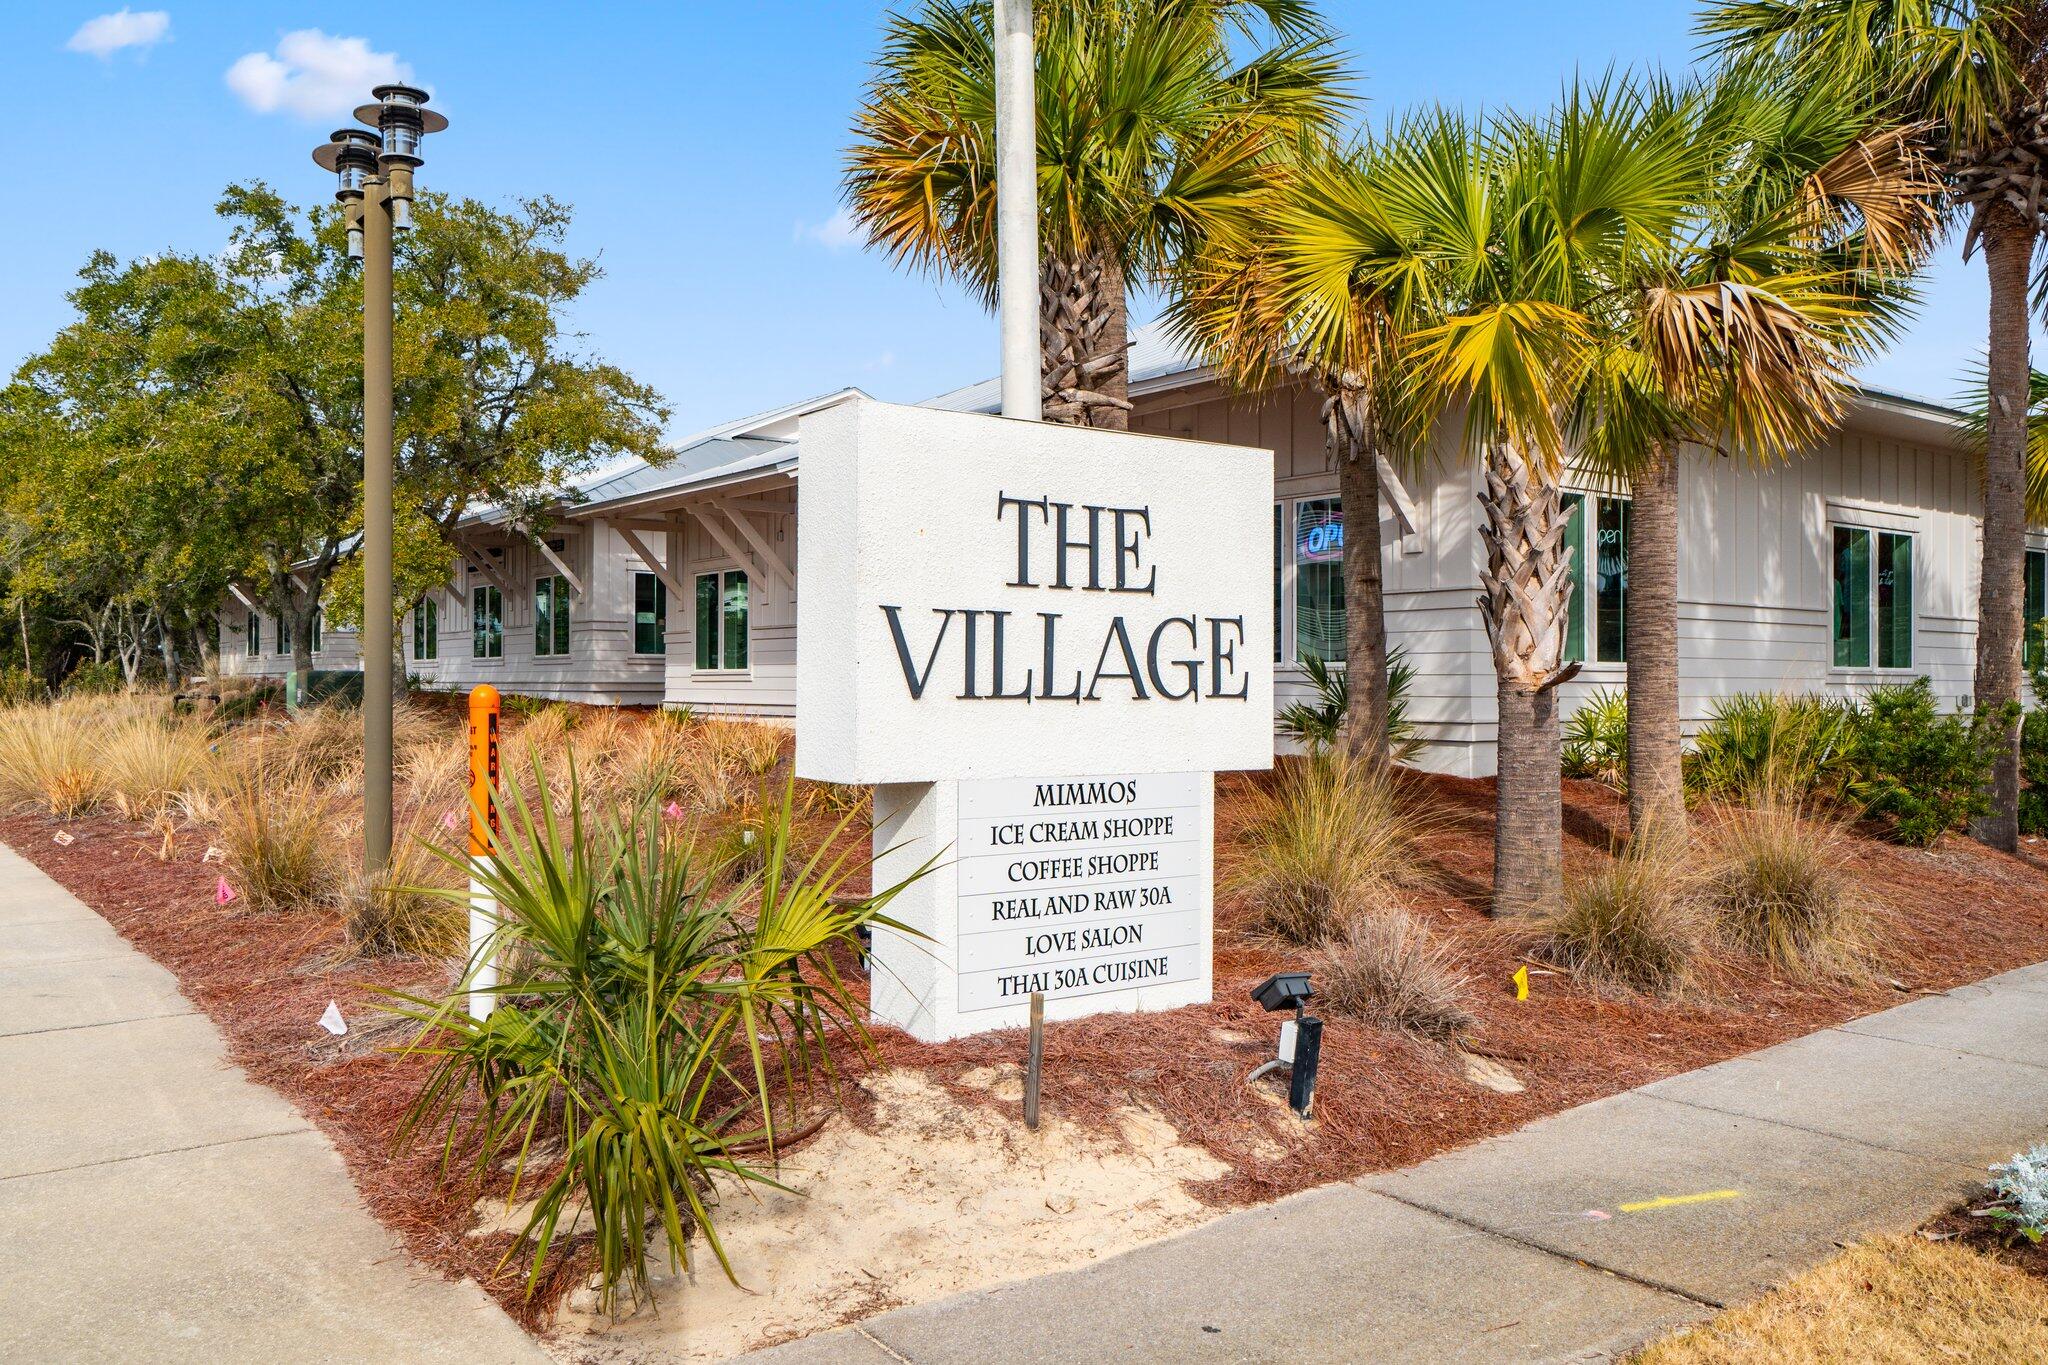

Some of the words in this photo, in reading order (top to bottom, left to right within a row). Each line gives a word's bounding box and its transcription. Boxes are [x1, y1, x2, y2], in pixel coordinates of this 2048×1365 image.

[998, 491, 1156, 597] THE
[1598, 529, 1621, 549] pen
[879, 604, 1249, 705] VILLAGE
[1034, 780, 1137, 807] MIMMOS
[991, 825, 1024, 846] ICE
[1029, 820, 1099, 843] CREAM
[1103, 815, 1173, 839] SHOPPE
[1008, 856, 1083, 883] COFFEE
[1088, 850, 1159, 876] SHOPPE
[992, 897, 1041, 921] REAL
[1044, 892, 1090, 915] AND
[1095, 889, 1137, 910] RAW
[1140, 886, 1173, 907] 30A
[1025, 934, 1077, 958] LOVE
[1082, 924, 1143, 951] SALON
[998, 971, 1050, 997] THAI
[1054, 966, 1090, 990] 30A
[1092, 956, 1168, 984] CUISINE
